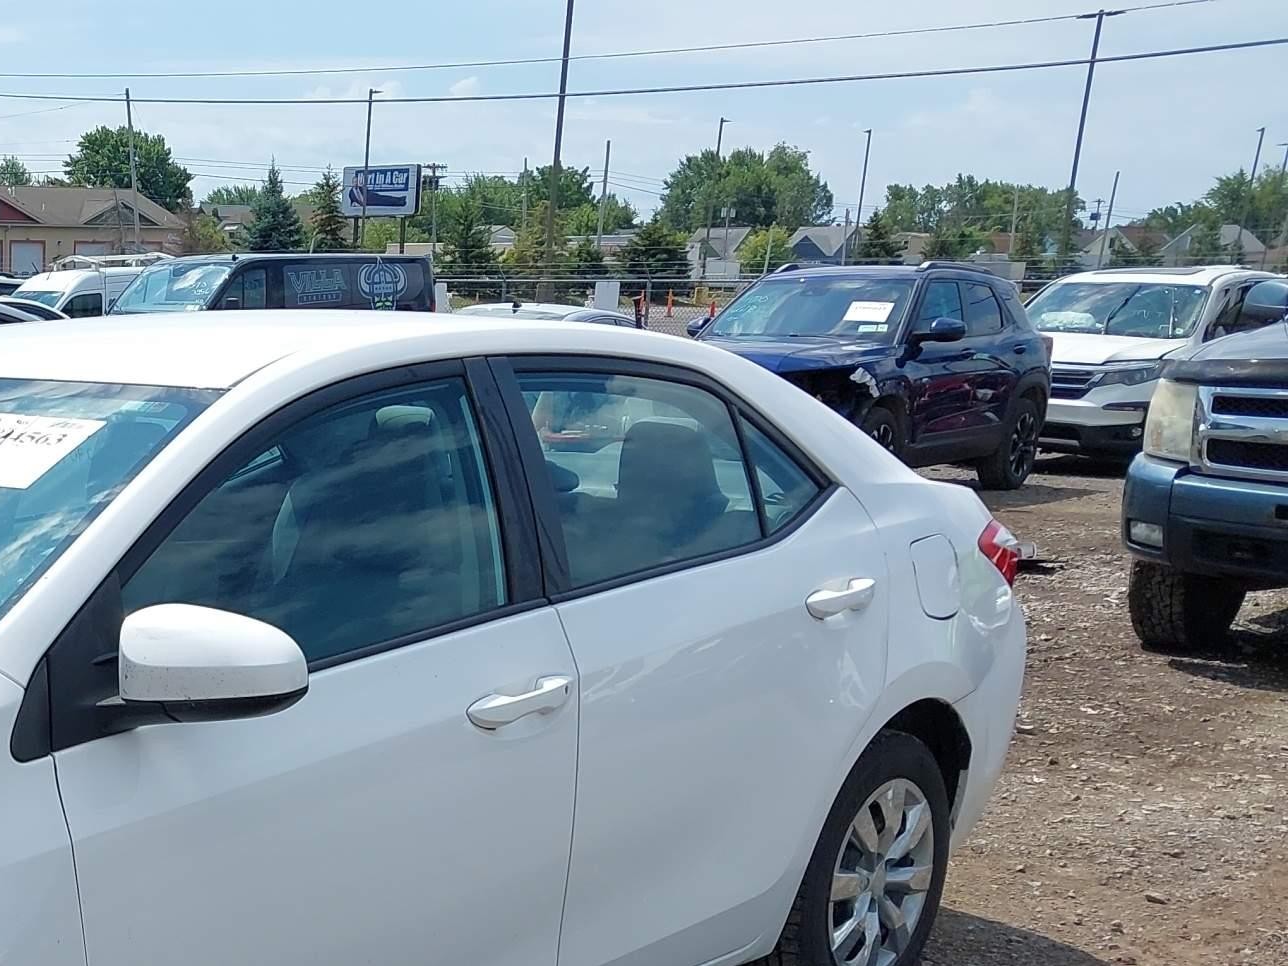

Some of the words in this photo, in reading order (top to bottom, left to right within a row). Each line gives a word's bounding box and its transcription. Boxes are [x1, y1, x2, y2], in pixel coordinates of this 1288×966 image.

[357, 172, 376, 186] Hrt
[392, 170, 409, 185] Car
[288, 268, 347, 294] VILLA
